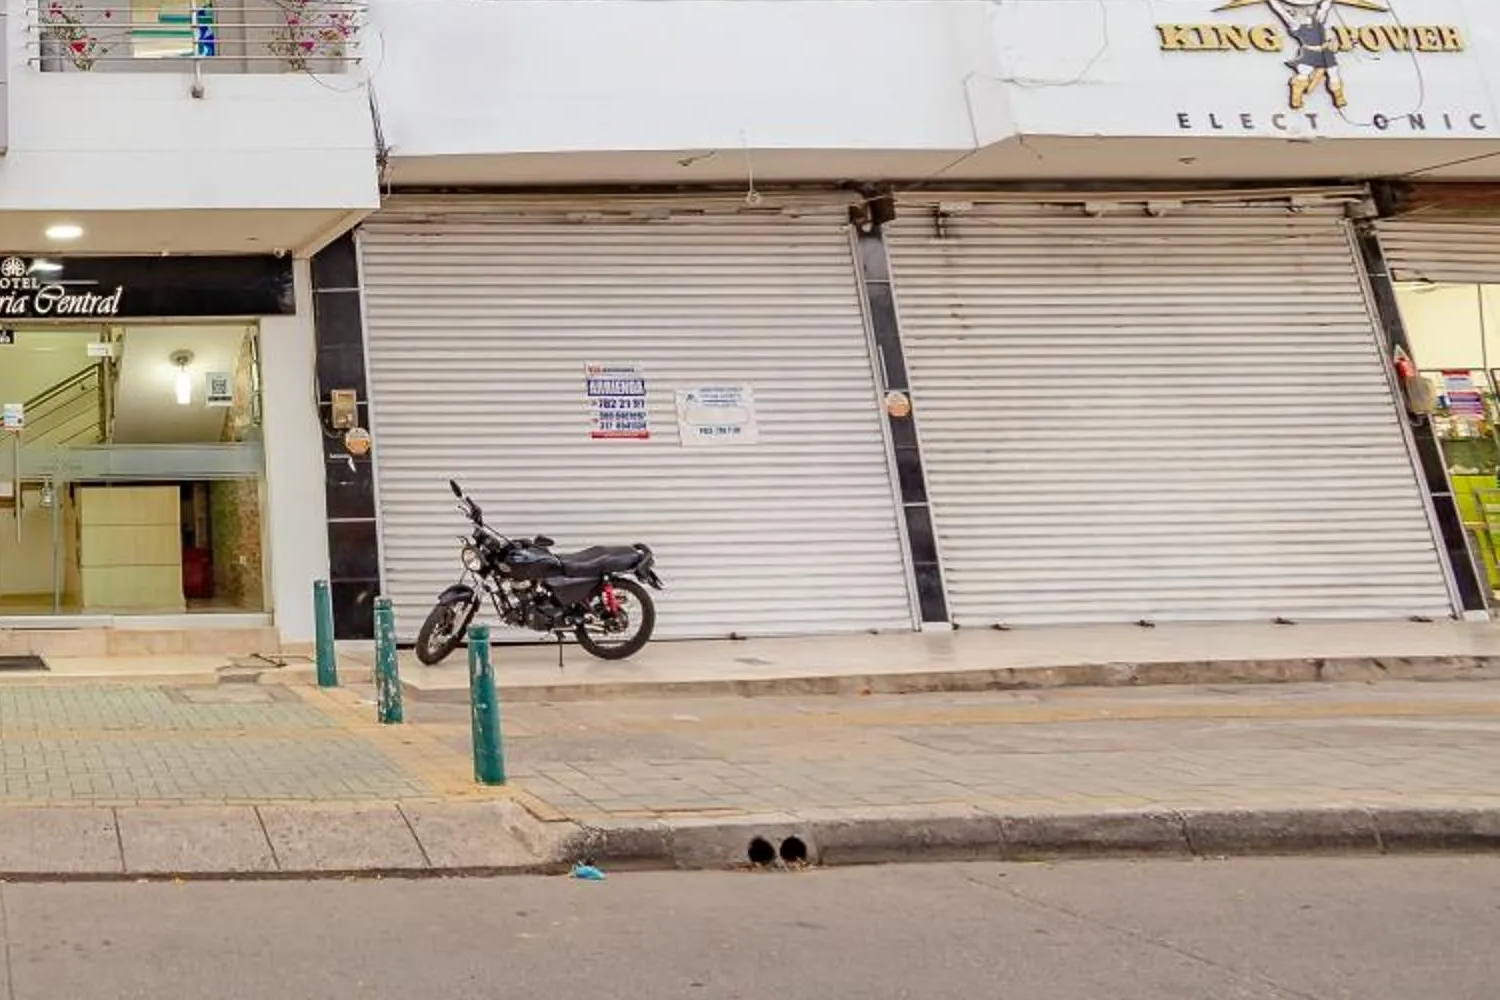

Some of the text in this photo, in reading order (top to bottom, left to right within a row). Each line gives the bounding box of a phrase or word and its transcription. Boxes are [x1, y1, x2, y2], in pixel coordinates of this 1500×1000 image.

[1155, 23, 1464, 53] KING POWER
[33, 284, 124, 316] Central
